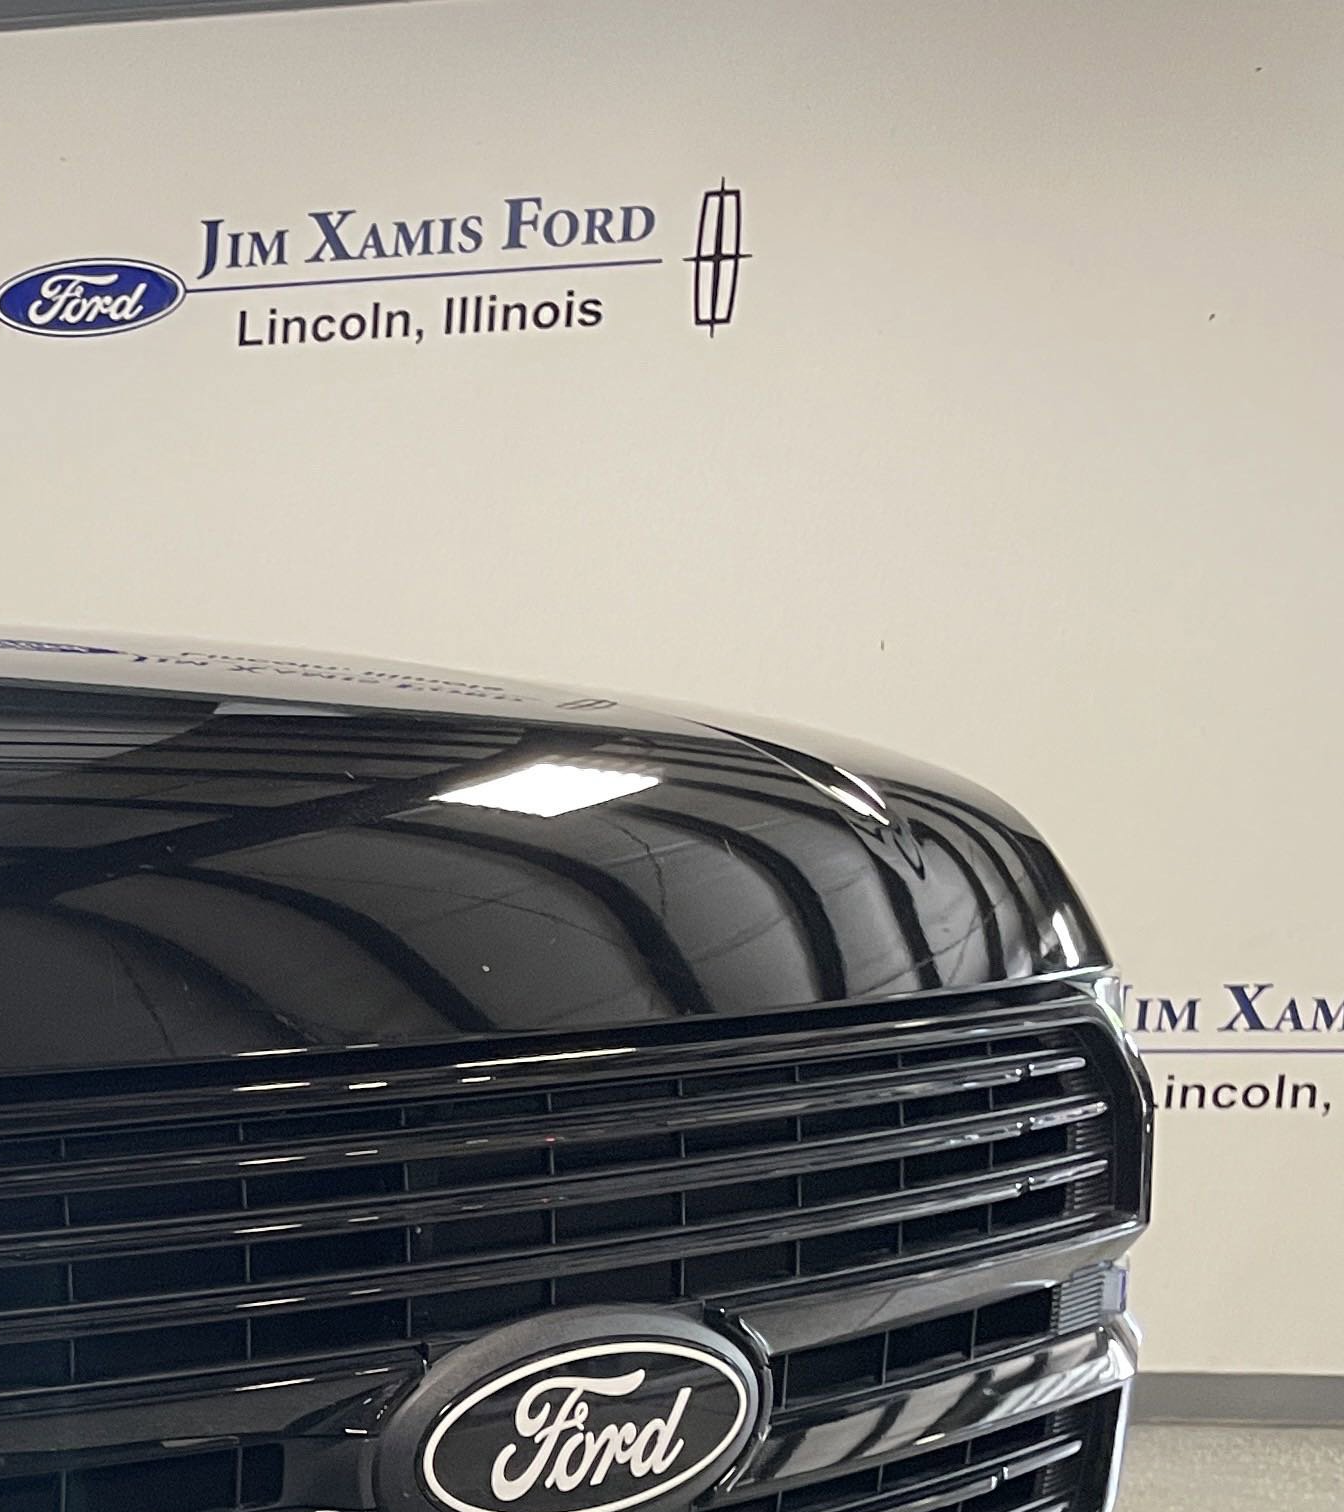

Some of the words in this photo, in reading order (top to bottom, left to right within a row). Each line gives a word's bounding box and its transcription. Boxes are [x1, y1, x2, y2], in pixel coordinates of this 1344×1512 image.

[197, 218, 290, 281] JIM
[304, 209, 484, 264] XAMIS
[502, 196, 656, 251] FORD
[27, 272, 148, 326] Ford
[238, 301, 424, 347] Lincoln,
[444, 289, 604, 335] Illinois
[1153, 1073, 1331, 1117] incoln,
[490, 1368, 693, 1502] Ford
